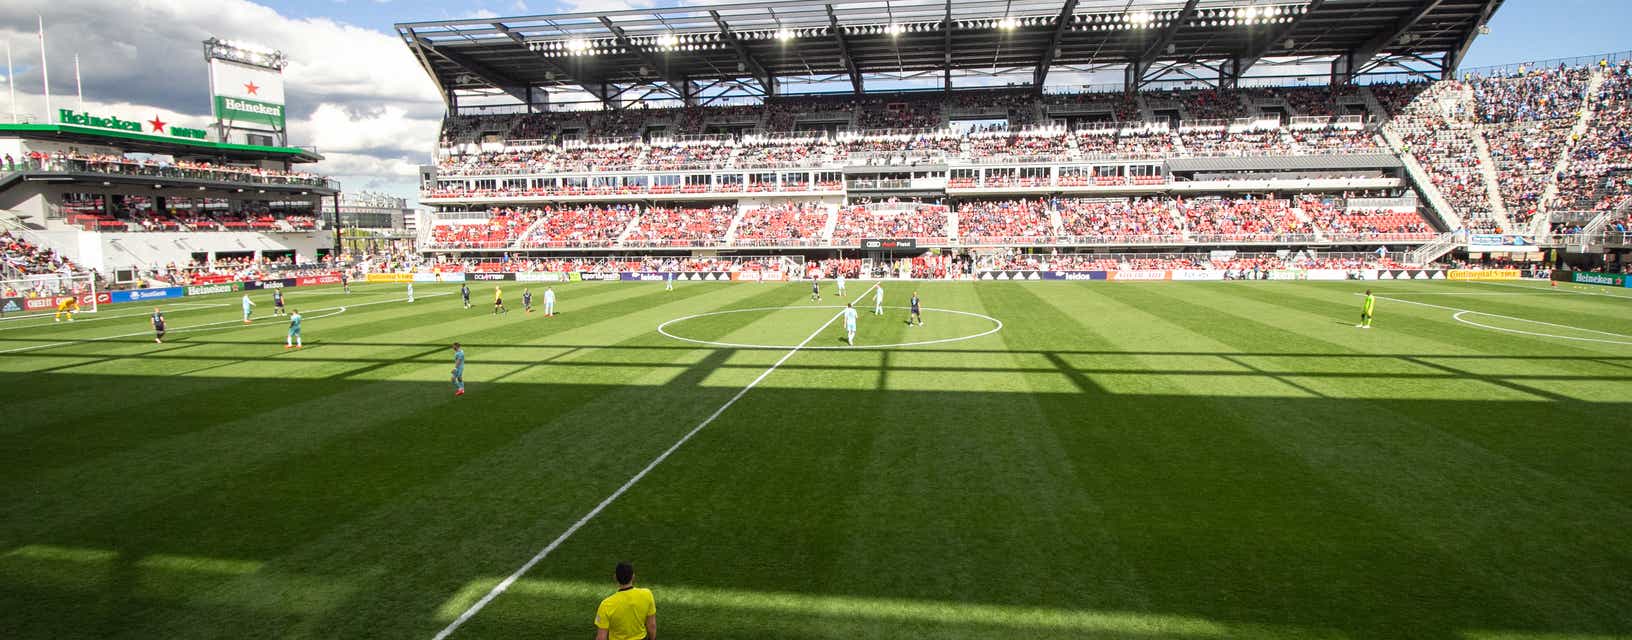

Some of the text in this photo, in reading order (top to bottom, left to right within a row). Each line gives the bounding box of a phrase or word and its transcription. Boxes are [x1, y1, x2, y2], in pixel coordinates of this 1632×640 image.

[225, 98, 281, 116] Heineken
[58, 108, 143, 132] Heineken
[1065, 271, 1091, 281] leidos
[1575, 272, 1614, 285] Heineken
[187, 284, 232, 296] Heineken
[263, 280, 284, 289] leidos
